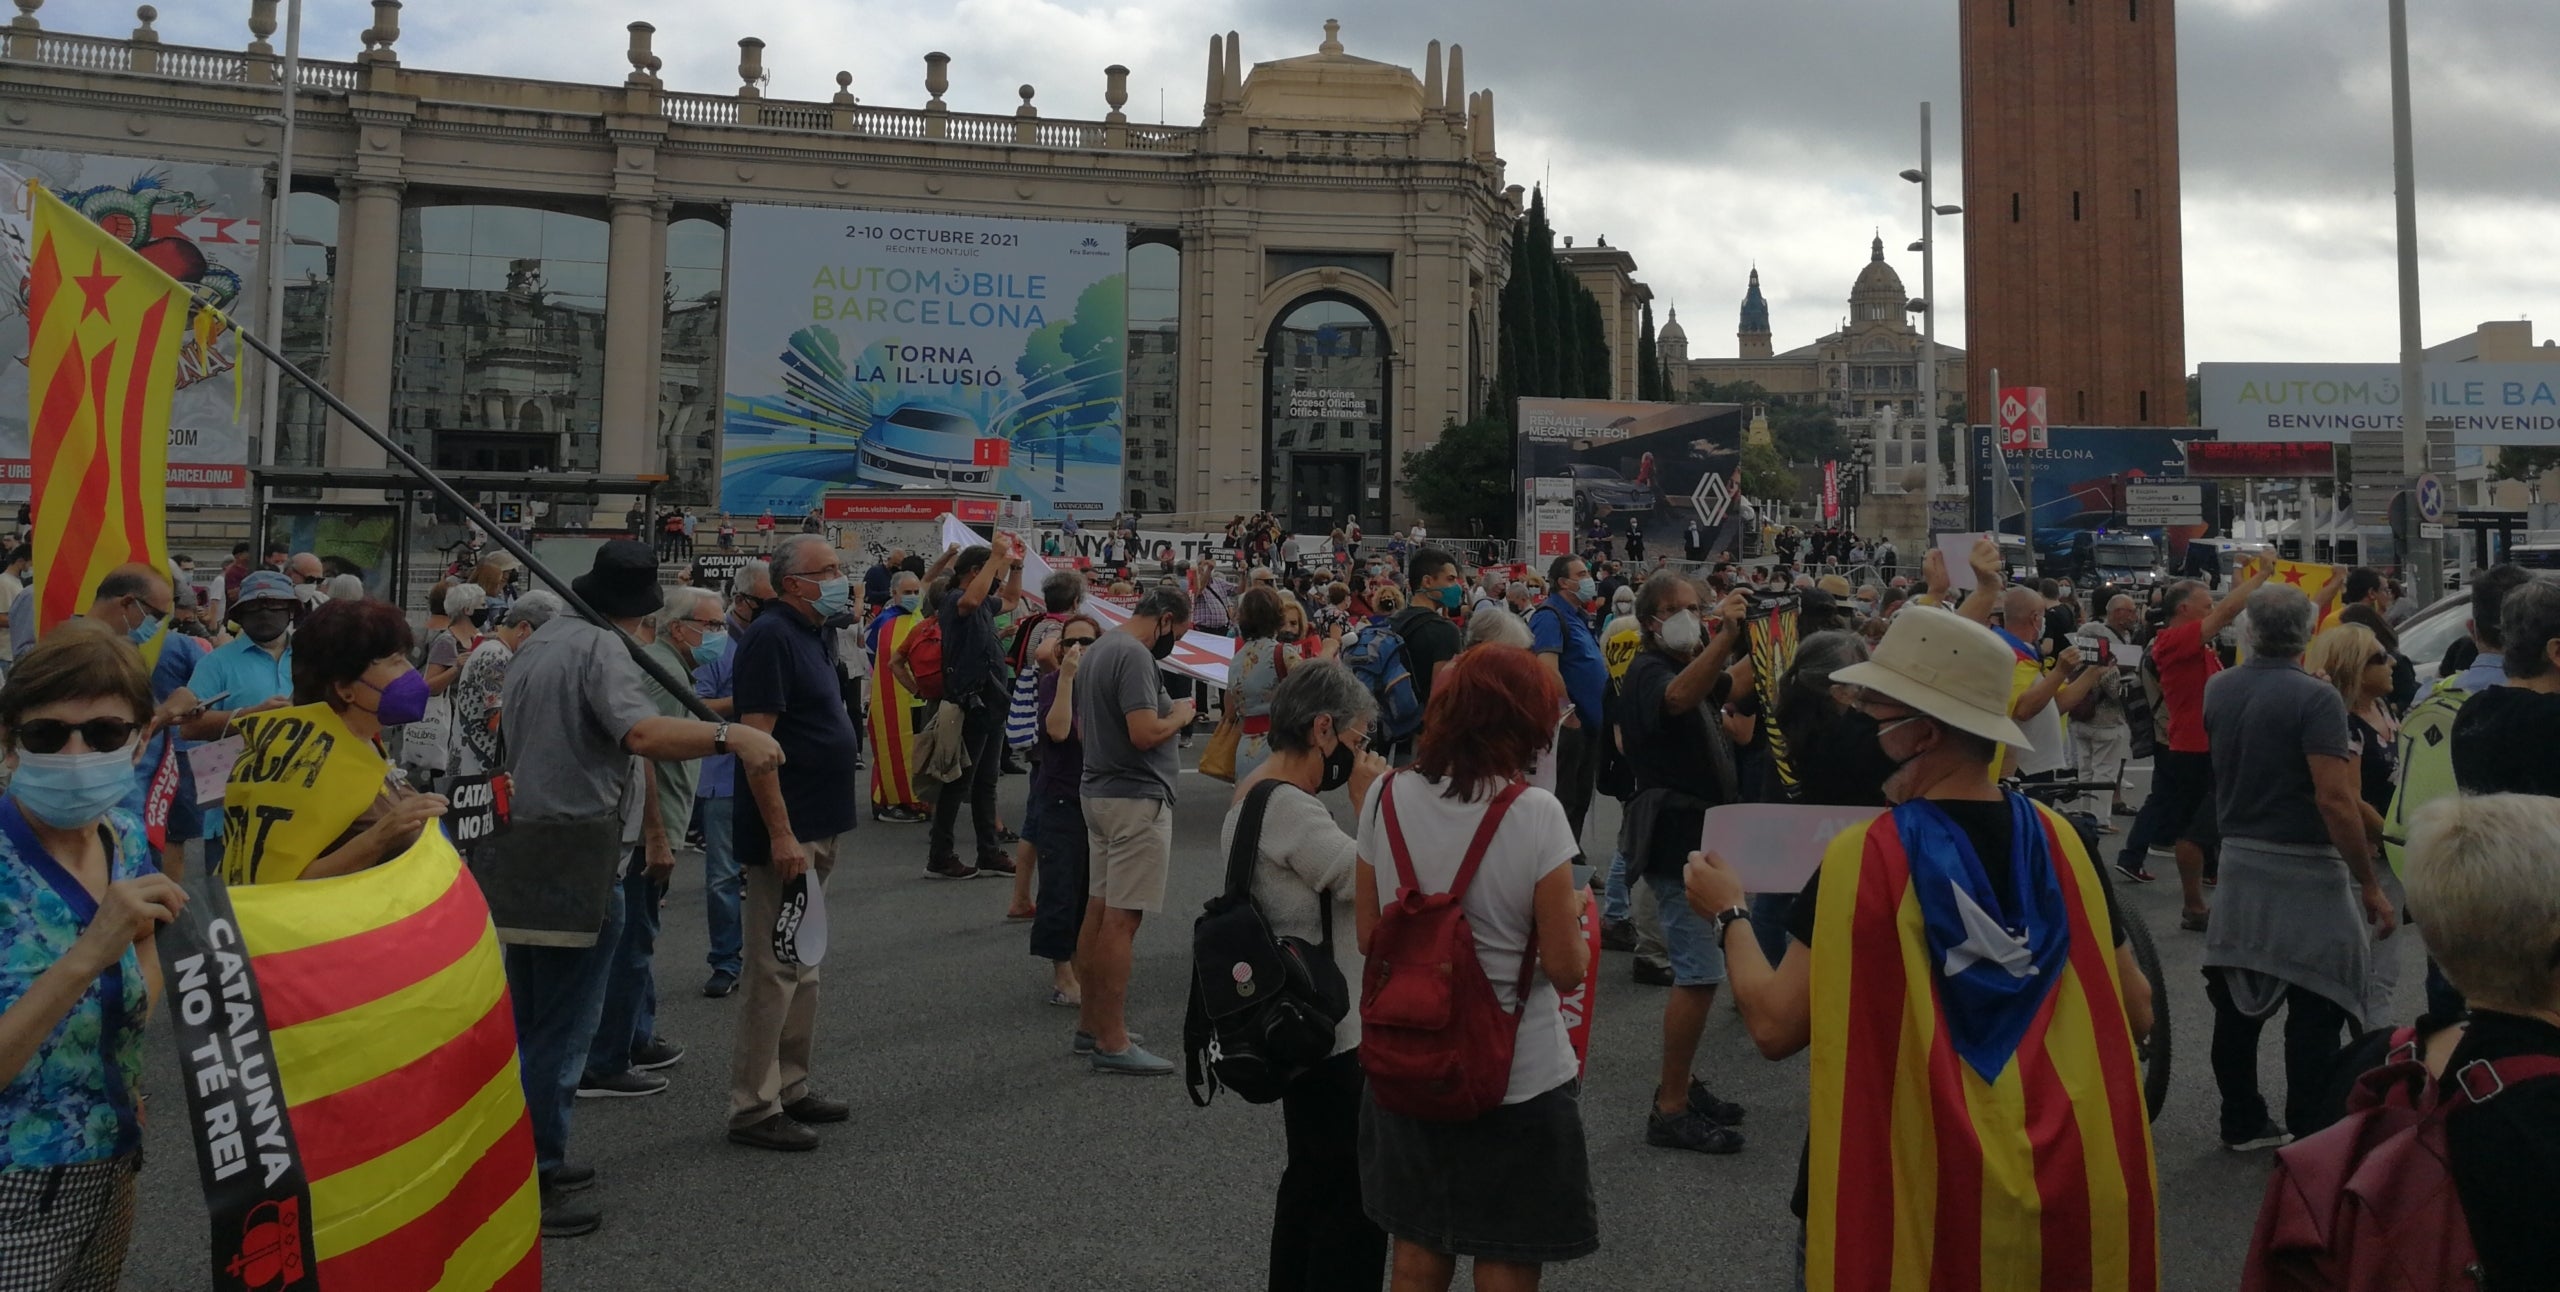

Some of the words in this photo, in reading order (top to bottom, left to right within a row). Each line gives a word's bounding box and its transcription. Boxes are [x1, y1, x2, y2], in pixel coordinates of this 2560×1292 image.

[845, 225, 884, 240] 2-10
[889, 227, 975, 245] OCTUBRE
[980, 232, 1020, 248] 2021
[885, 244, 928, 255] RECINTE
[930, 246, 980, 258] MONTJUÏC
[812, 295, 1047, 330] BARCELONA
[885, 344, 974, 365] TORNA
[854, 364, 886, 383] LA
[1319, 389, 1356, 399] Oficines
[2238, 377, 2484, 406] AUTOMOILE
[2502, 381, 2560, 406] BA
[1289, 398, 1326, 408] Acceso
[1327, 398, 1367, 409] Oficinas
[1289, 407, 1319, 417] Office
[1320, 408, 1364, 418] Entrance
[1529, 415, 1588, 427] RENAULT
[2267, 413, 2404, 430] BENVINGUTS
[698, 555, 758, 566] CATALUNYA
[703, 568, 720, 578] NO
[721, 565, 735, 578] TÉ
[157, 798, 168, 827] NO
[458, 815, 481, 841] NO
[776, 901, 793, 933] NO
[174, 952, 213, 1027] NO
[208, 916, 292, 1190] CATALUNYA
[191, 1032, 238, 1098] TÉ
[204, 1099, 249, 1183] REI
